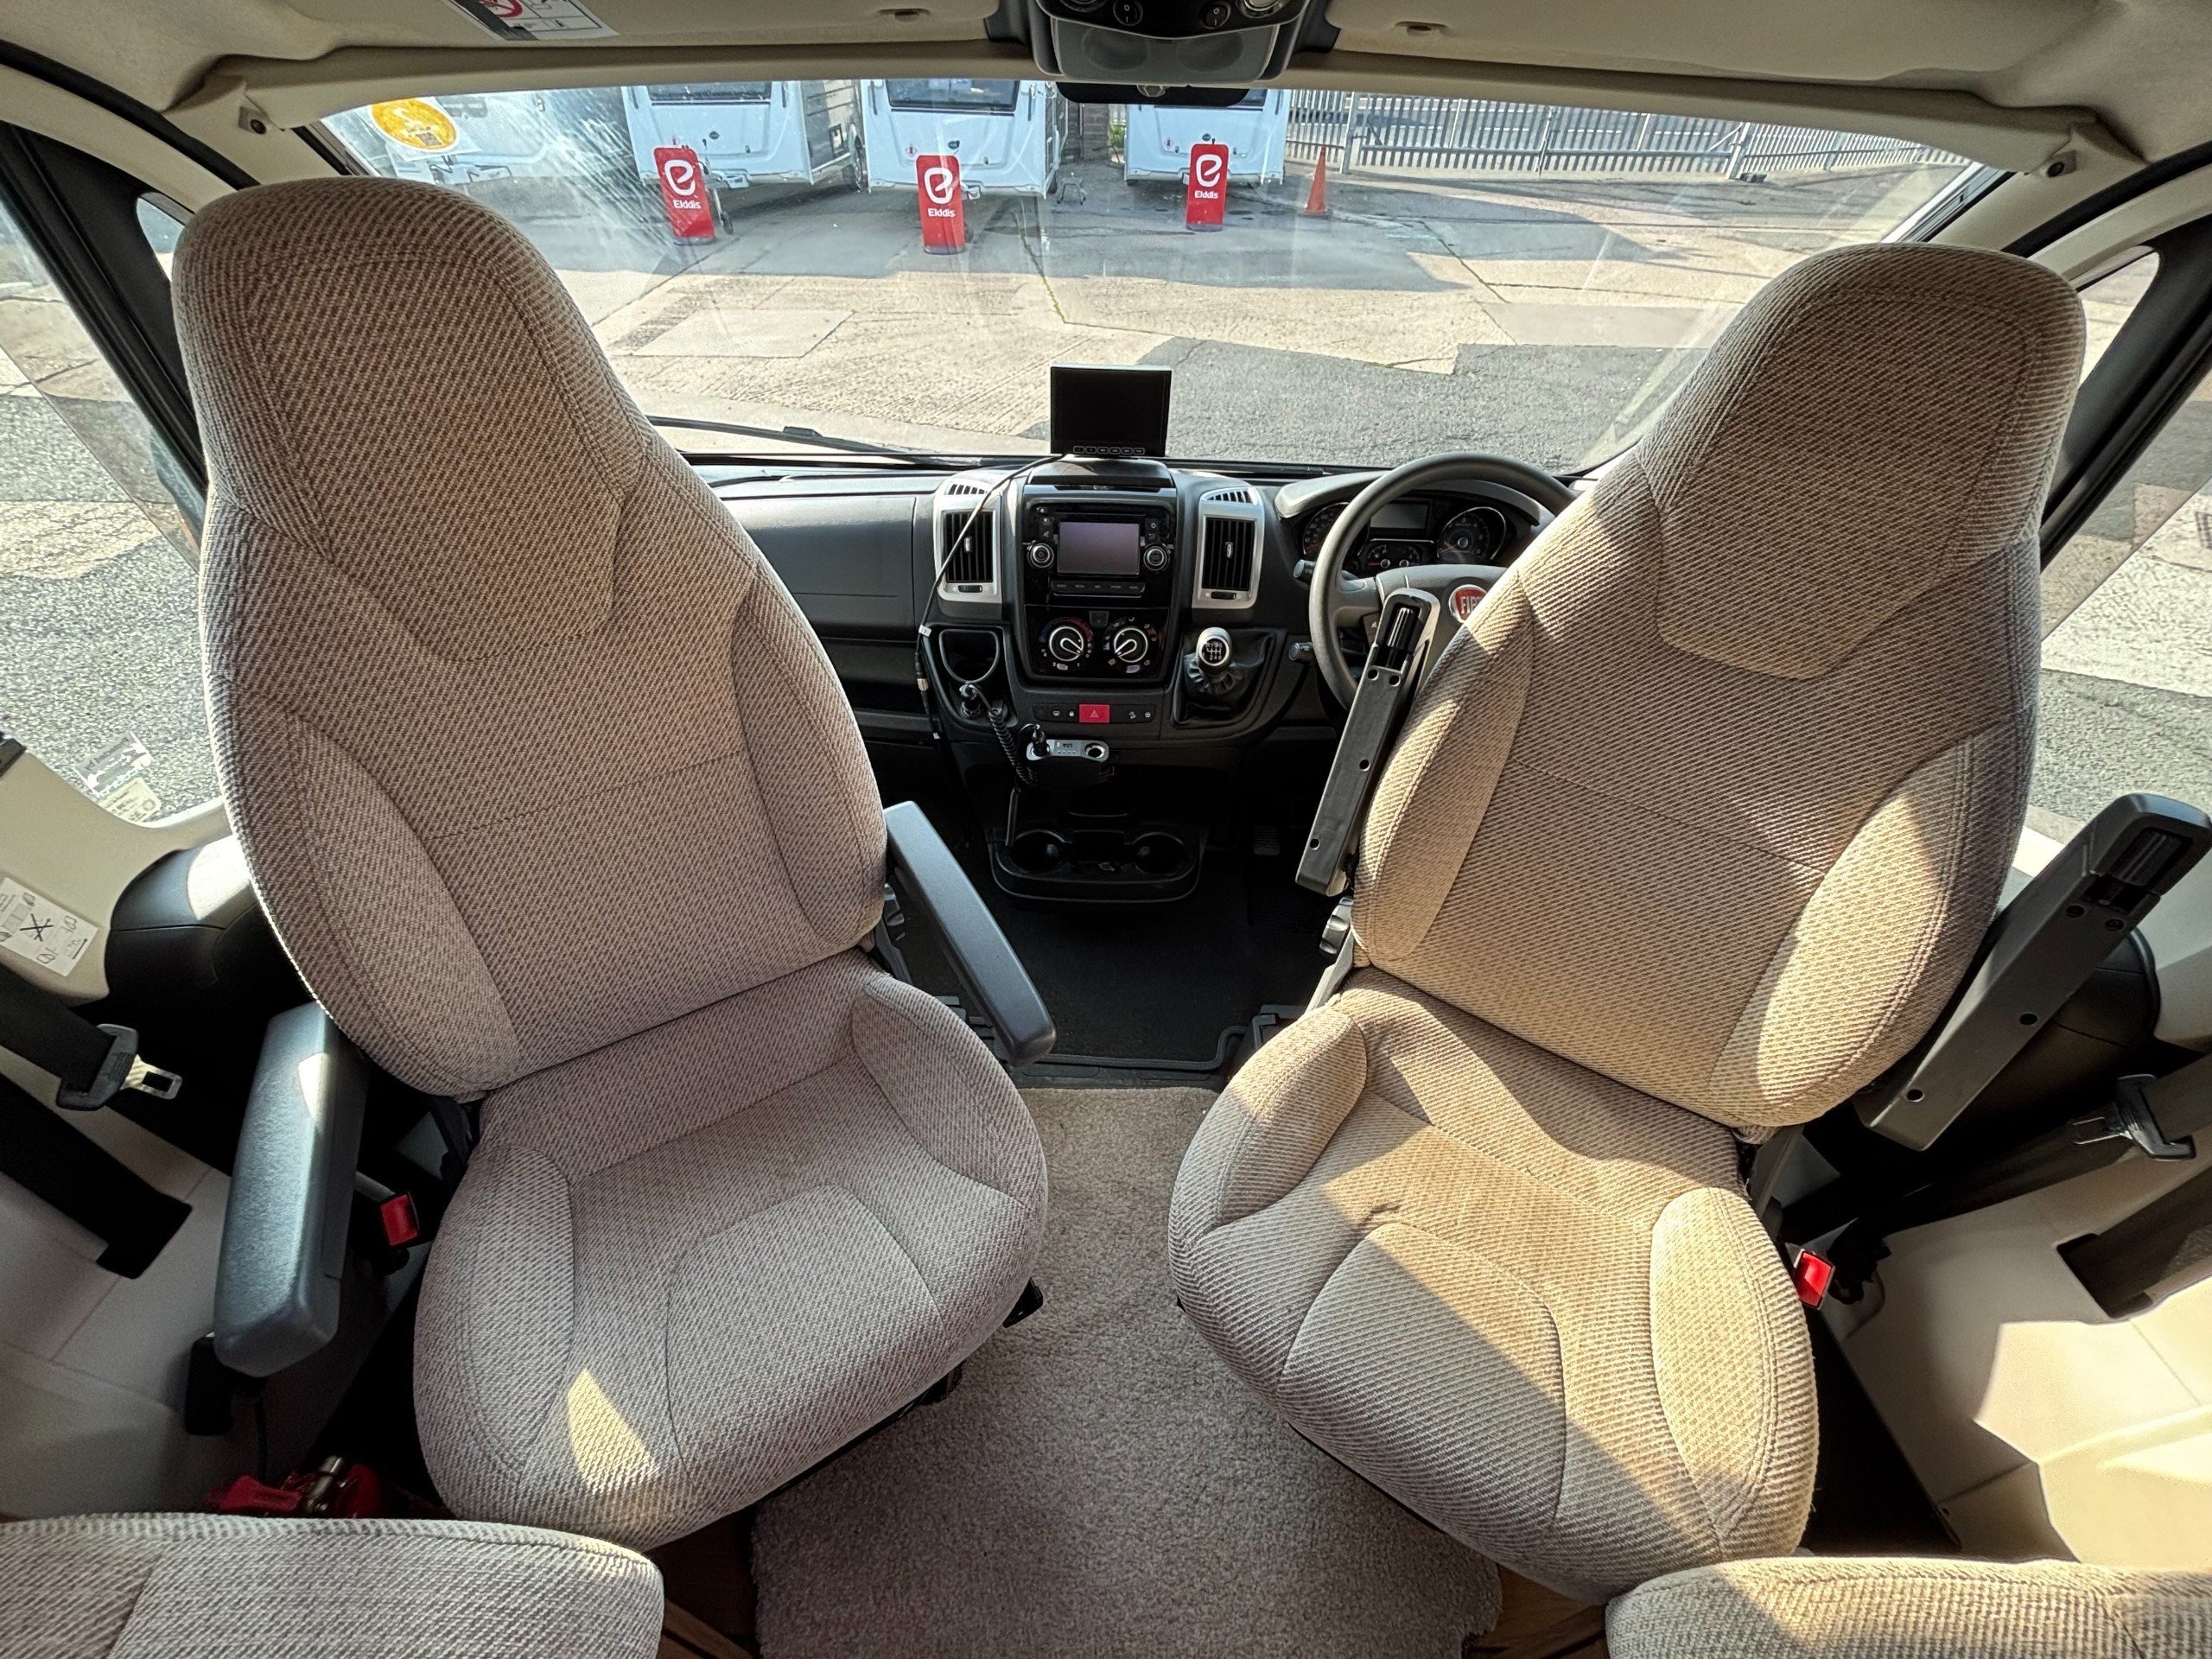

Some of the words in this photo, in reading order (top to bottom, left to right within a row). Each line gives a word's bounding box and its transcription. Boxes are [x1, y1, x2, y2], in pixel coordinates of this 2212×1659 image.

[1194, 190, 1219, 200] Elddis
[673, 200, 702, 209] Elddis
[927, 207, 956, 217] Elddis
